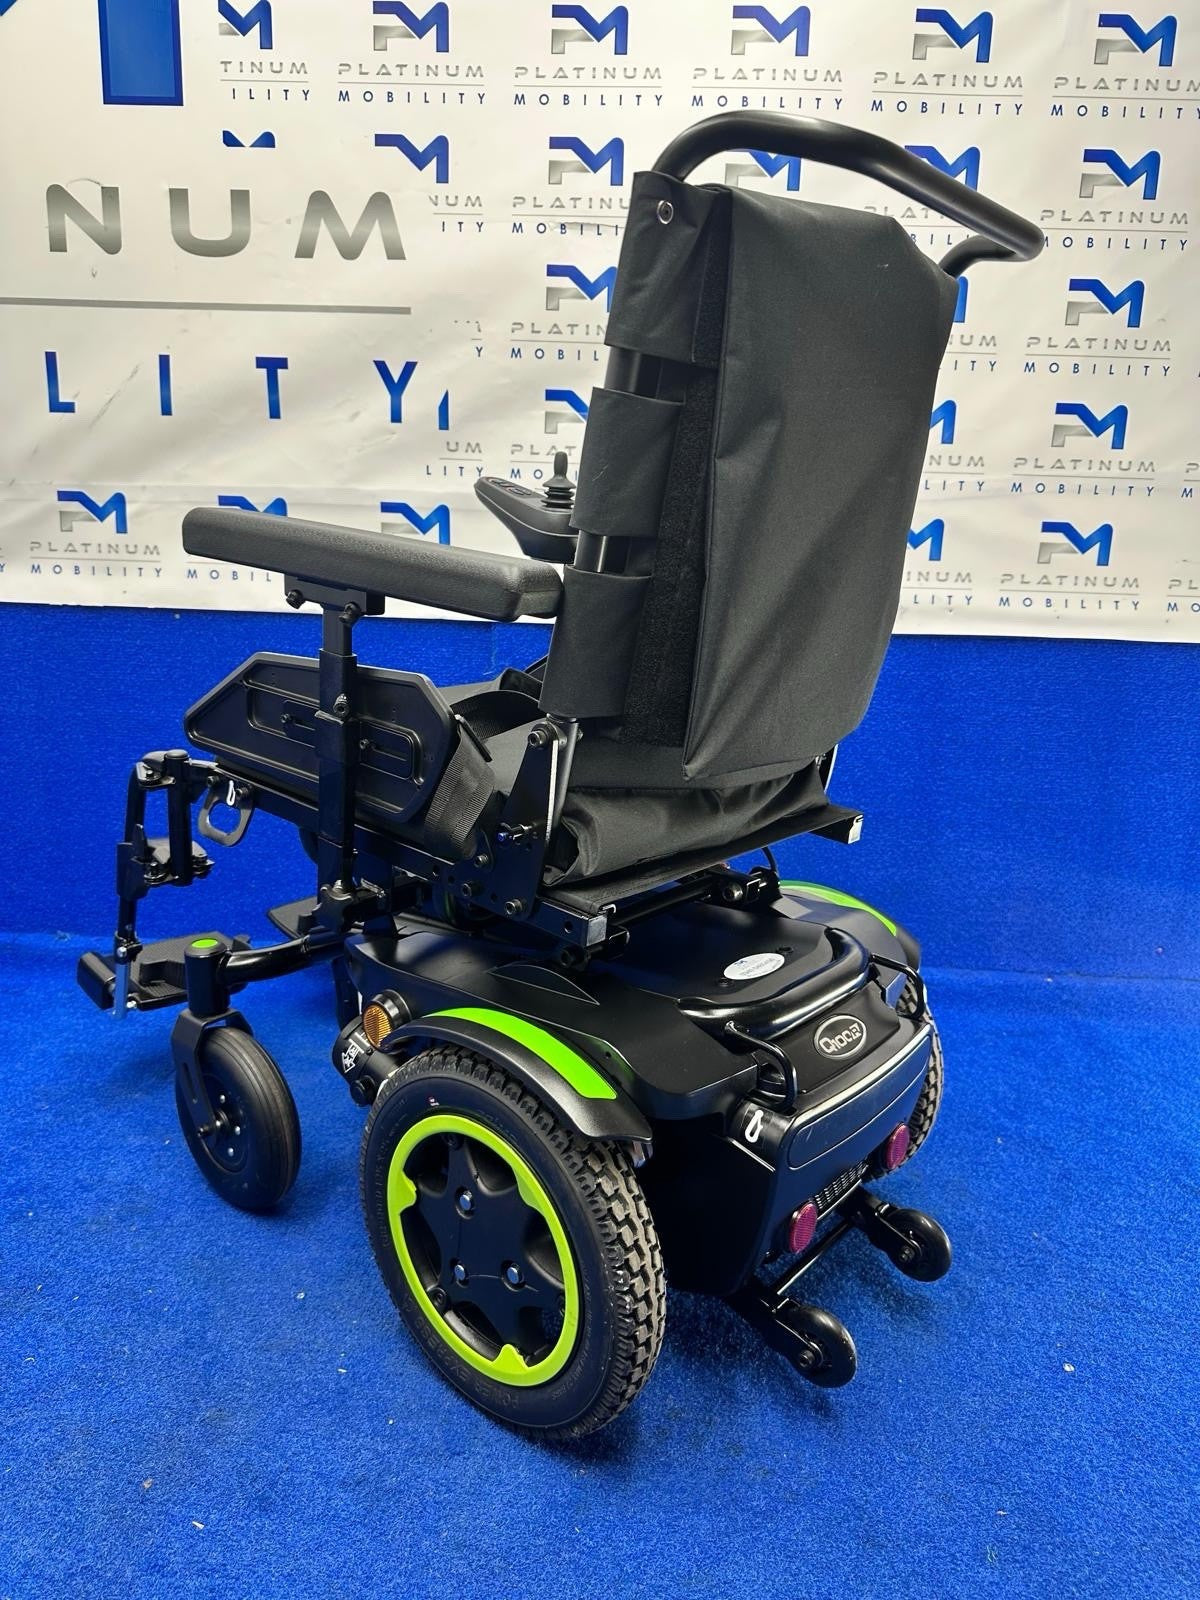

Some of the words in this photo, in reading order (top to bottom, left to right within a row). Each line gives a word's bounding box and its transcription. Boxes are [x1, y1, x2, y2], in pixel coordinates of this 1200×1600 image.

[220, 60, 309, 75] TINUM
[338, 62, 485, 78] PLATINUM
[514, 66, 662, 80] PLATINUM
[693, 67, 842, 83] PLATINUM
[873, 72, 1024, 88] PLATINUM
[1054, 76, 1200, 93] PLATINUM
[232, 88, 310, 100] ILITY
[338, 90, 485, 104] MOBILITY
[514, 93, 663, 106] MOBILITY
[691, 95, 842, 109] MOBILITY
[871, 99, 1022, 114] MOBILITY
[46, 183, 407, 261] NUM
[1040, 209, 1189, 224] PLATINUM
[442, 221, 485, 232] ITY
[1026, 336, 1171, 352] PLATINUM
[510, 347, 599, 361] MOBIL
[1024, 362, 1171, 377] MOBILITY
[46, 351, 417, 423] LITY
[1014, 458, 1155, 473] PLATINUM
[1011, 483, 1154, 497] MOBILITY
[30, 541, 161, 556] PLATINUM
[31, 563, 163, 578] MOBILITY
[186, 569, 272, 583] MOBIL
[1000, 573, 1140, 589] PLATINUM
[998, 596, 1140, 611] MOBILITY
